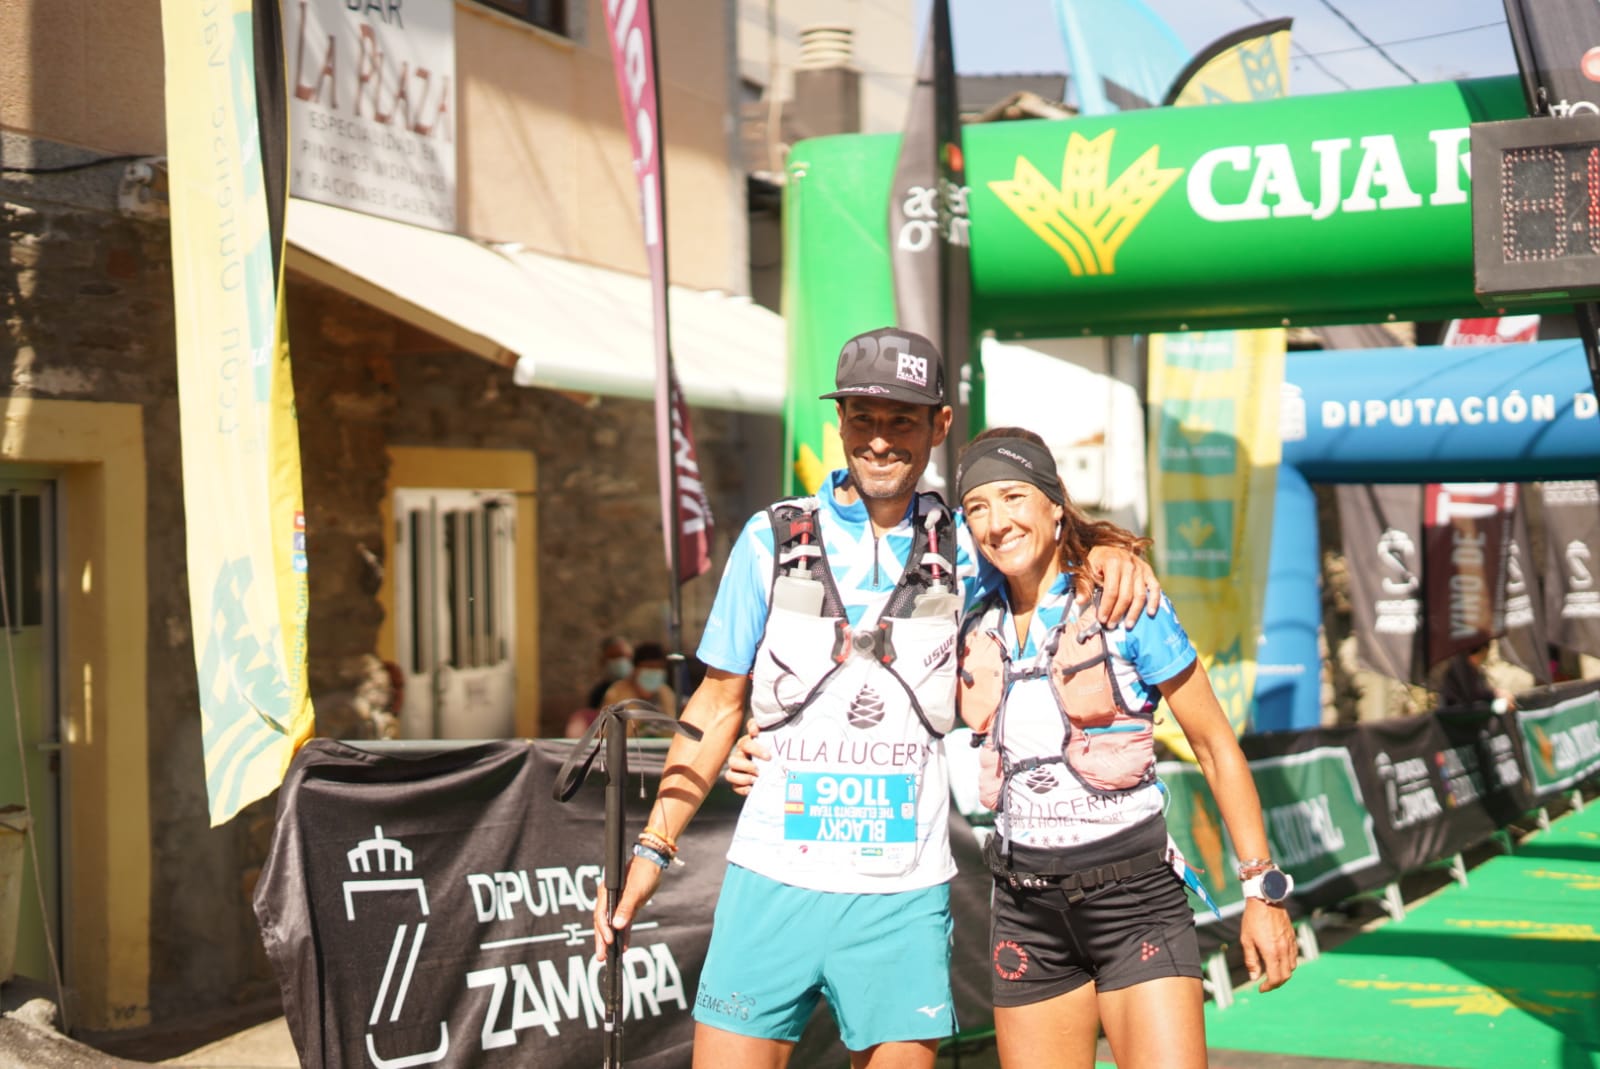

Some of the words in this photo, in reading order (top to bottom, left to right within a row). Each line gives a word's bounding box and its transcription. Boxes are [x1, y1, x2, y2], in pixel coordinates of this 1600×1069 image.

[1187, 134, 1422, 222] CAJA
[1322, 388, 1556, 428] DIPUTACIÓN
[1450, 531, 1486, 568] DE
[1448, 574, 1482, 637] VINO
[816, 776, 891, 806] 1106
[809, 804, 833, 817] TEAM
[834, 805, 876, 819] ELEMENTS
[877, 806, 895, 819] THE
[816, 817, 887, 842] BLACKY
[466, 943, 688, 1050] ZAMORA
